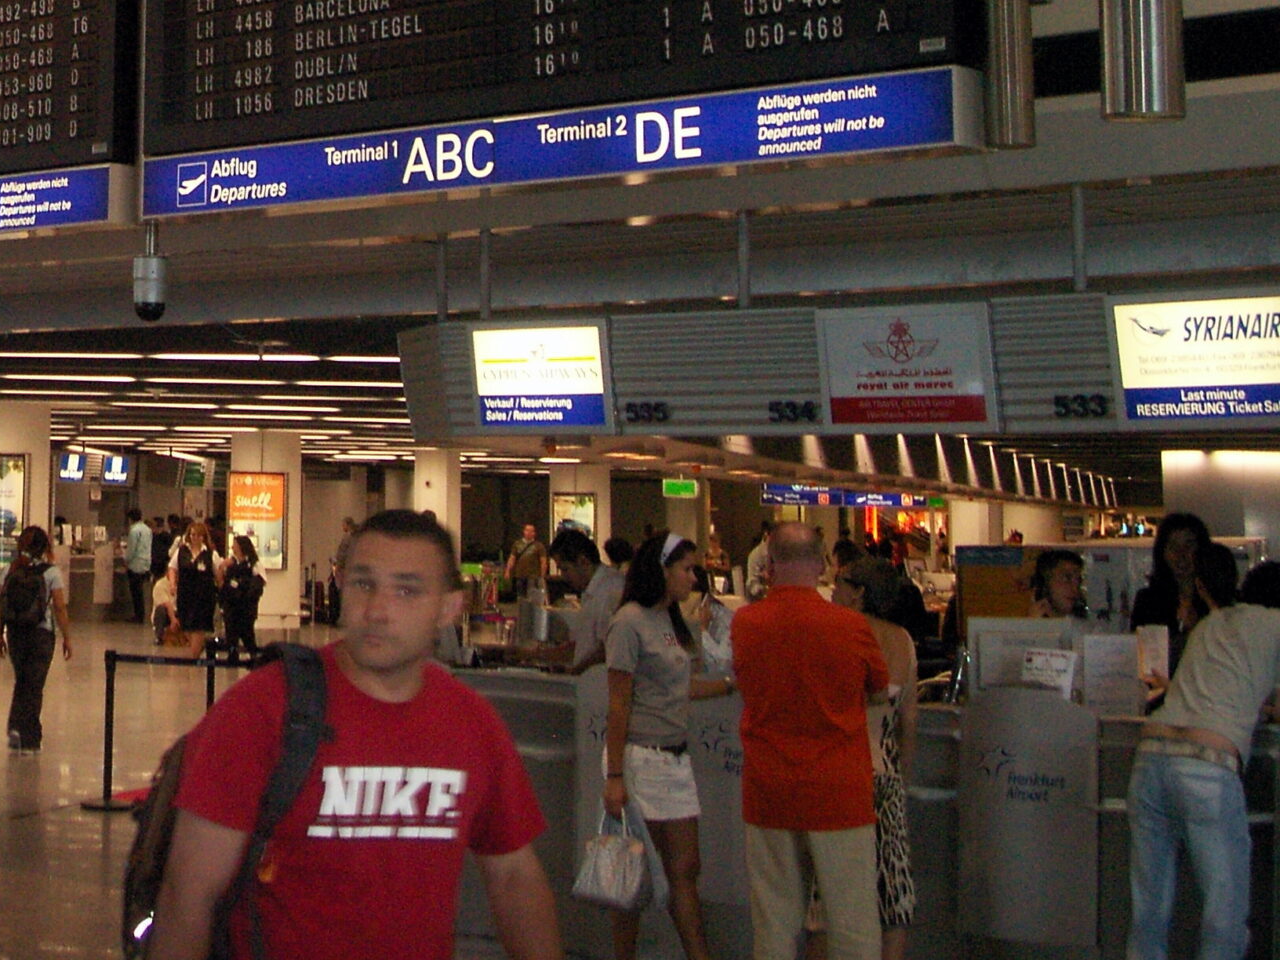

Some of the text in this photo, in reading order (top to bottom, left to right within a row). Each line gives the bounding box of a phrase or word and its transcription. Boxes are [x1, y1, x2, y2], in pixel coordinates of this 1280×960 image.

[295, 14, 423, 51] BERLIN-TEGEL
[294, 80, 369, 107] DRESDEN
[758, 84, 877, 111] Abflüge werden nicht
[758, 107, 819, 126] ausgerufen
[758, 114, 885, 142] Departures will not be
[537, 106, 702, 164] Terminal 2 DE
[324, 129, 494, 184] Terminal 1 ABC
[758, 138, 822, 157] announced
[211, 158, 257, 178] Abflug
[210, 181, 287, 205] Departures
[1183, 311, 1280, 342] SYRIANAIR
[484, 397, 514, 409] Verkauf
[520, 396, 573, 410] Reservierung
[1054, 393, 1109, 419] 533
[1180, 388, 1246, 401] Last minute
[513, 409, 564, 422] Reservations
[768, 400, 817, 424] 534
[1136, 401, 1226, 418] RESERVIERUNG
[1227, 399, 1263, 414] Ticket
[234, 491, 273, 511] smell
[320, 765, 468, 818] NIKE
